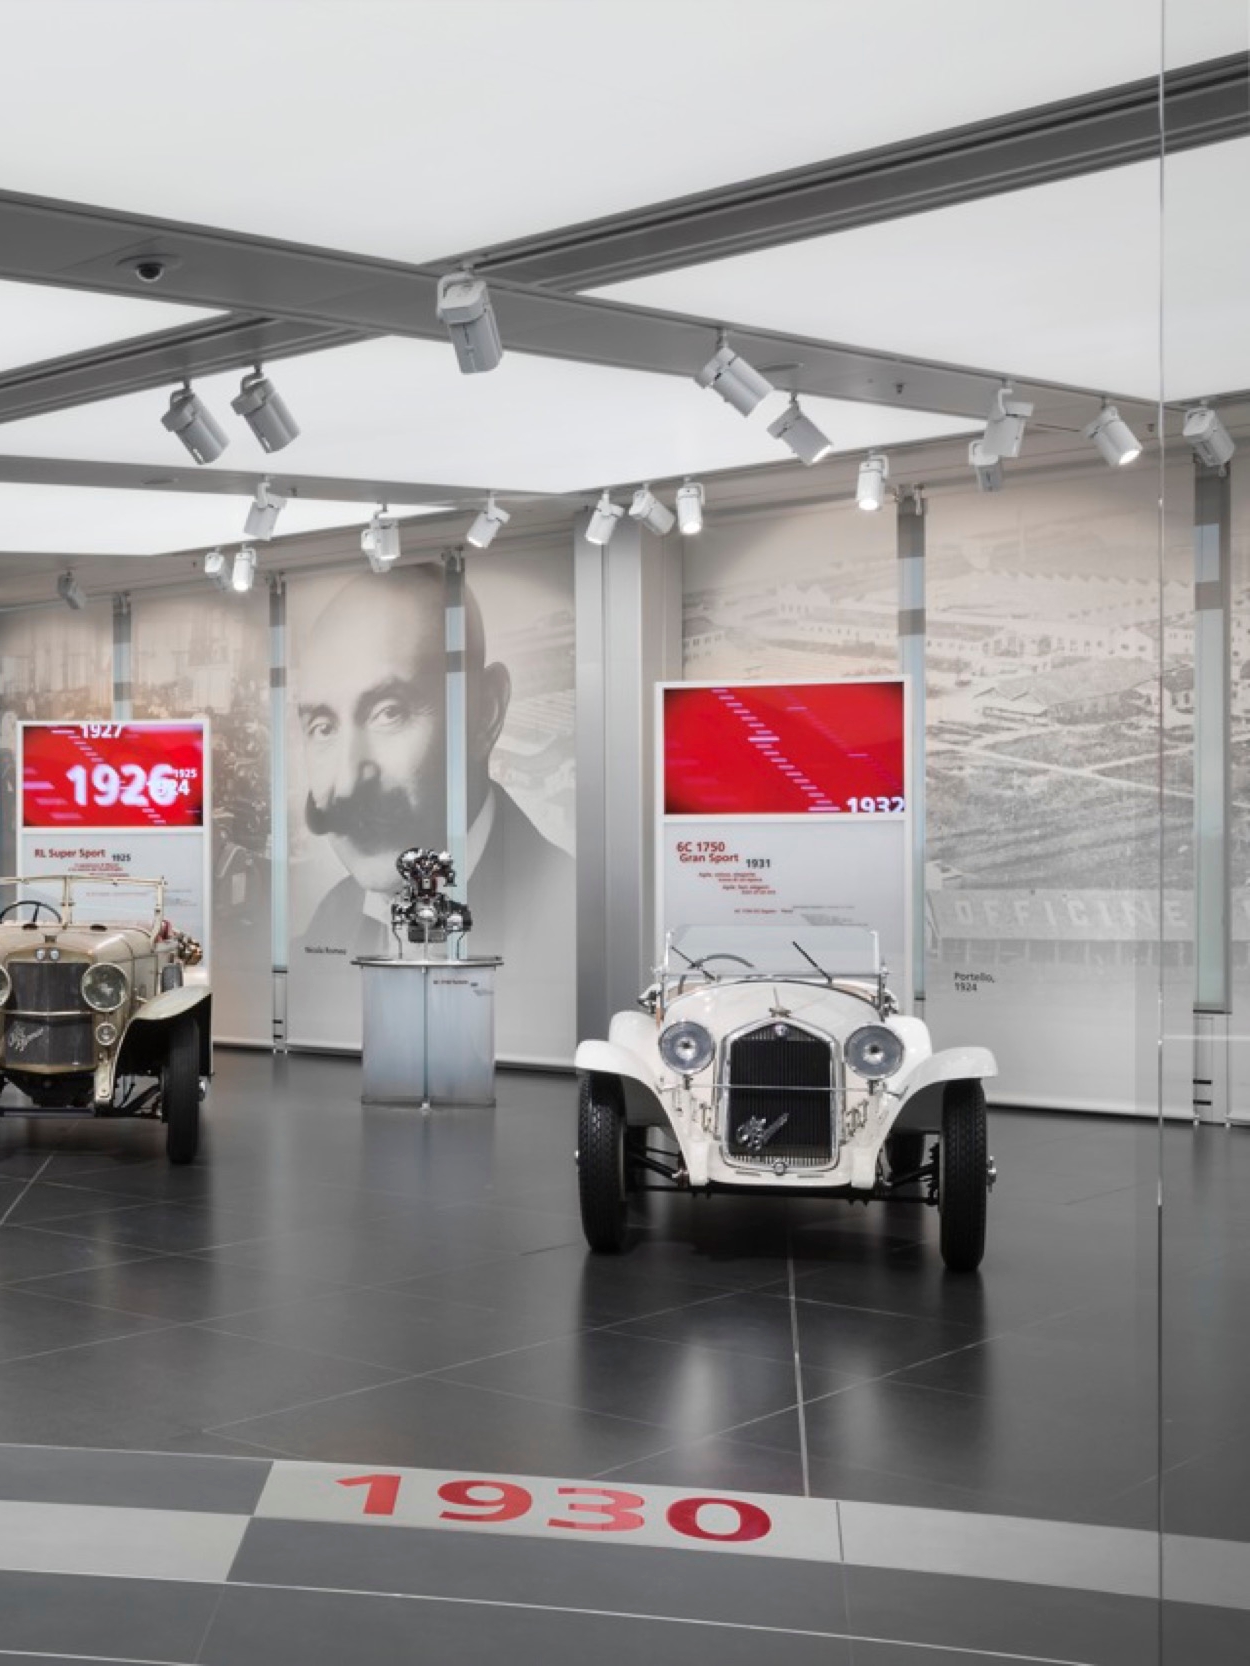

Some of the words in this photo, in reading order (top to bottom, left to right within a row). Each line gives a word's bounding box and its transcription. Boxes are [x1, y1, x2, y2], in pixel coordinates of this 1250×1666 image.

[81, 723, 121, 739] 1927
[65, 763, 179, 806] 1926
[846, 796, 906, 813] 1932
[677, 842, 693, 852] 6C
[696, 842, 726, 852] 1750
[48, 849, 76, 859] Super
[79, 849, 106, 859] Sport
[679, 853, 706, 862] Gran
[709, 853, 739, 864] Sport
[746, 859, 771, 868] 1931
[954, 972, 995, 983] Portello,
[336, 1474, 771, 1541] 1930
